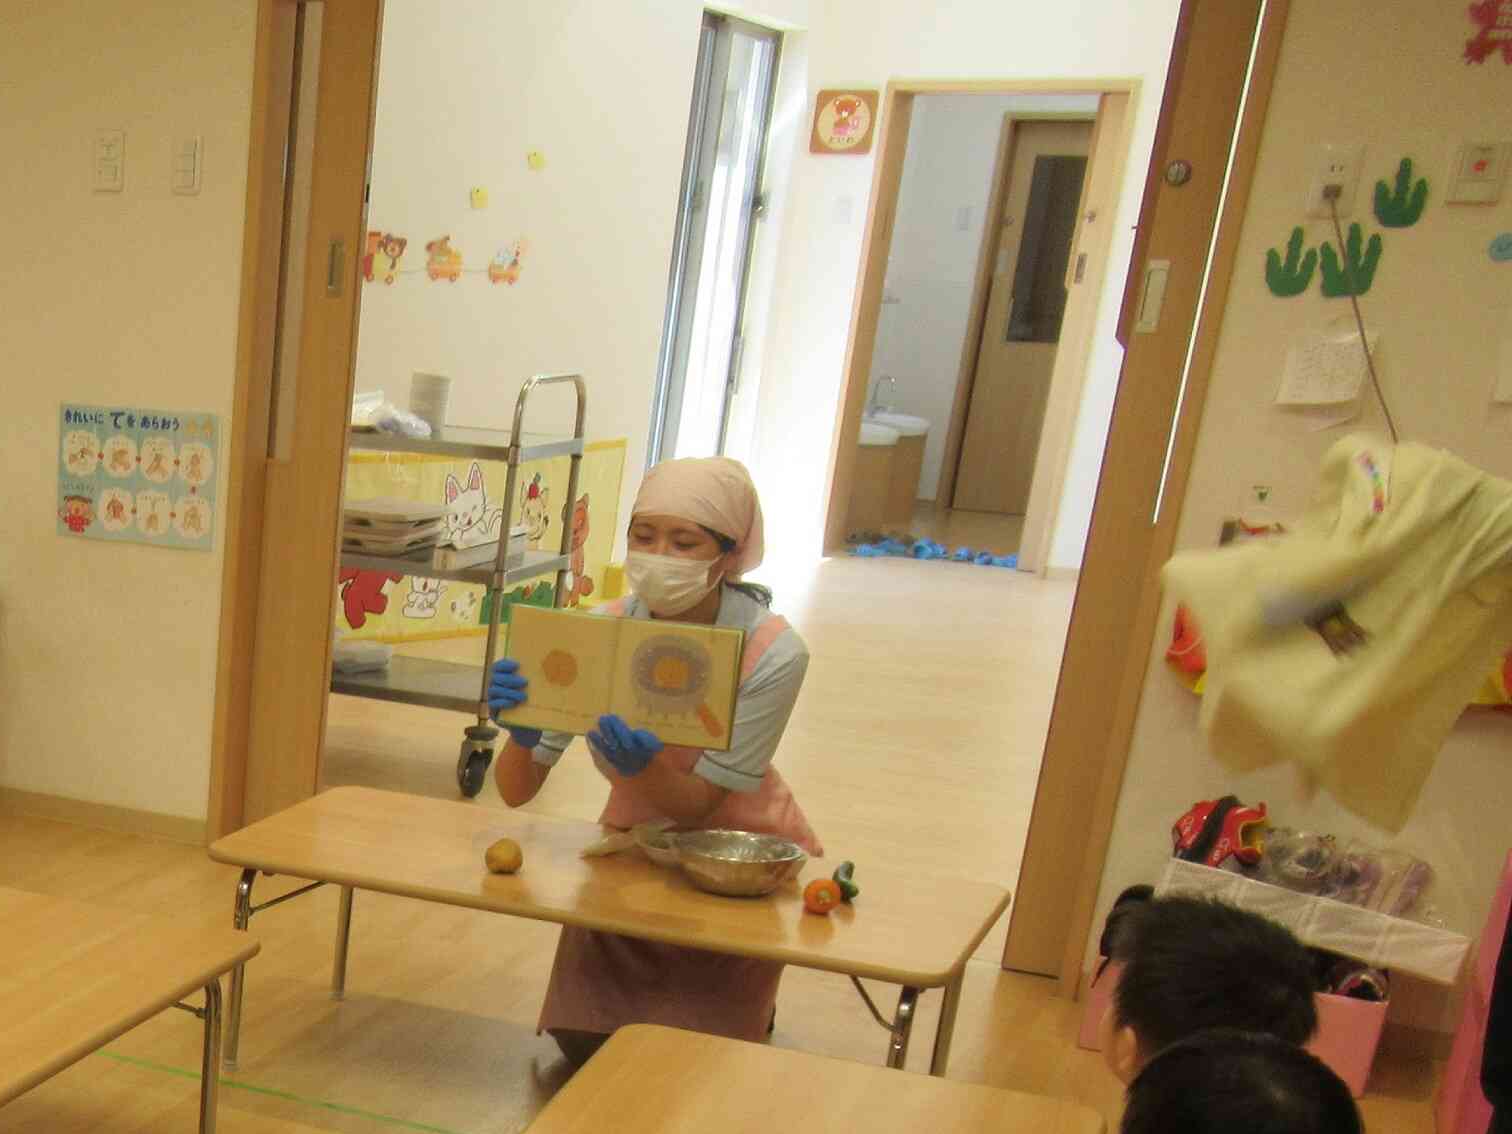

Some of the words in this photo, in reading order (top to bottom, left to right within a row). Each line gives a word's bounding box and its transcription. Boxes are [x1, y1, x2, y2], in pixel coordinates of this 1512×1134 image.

[64, 407, 105, 425] きれいに
[139, 416, 181, 432] あらおう
